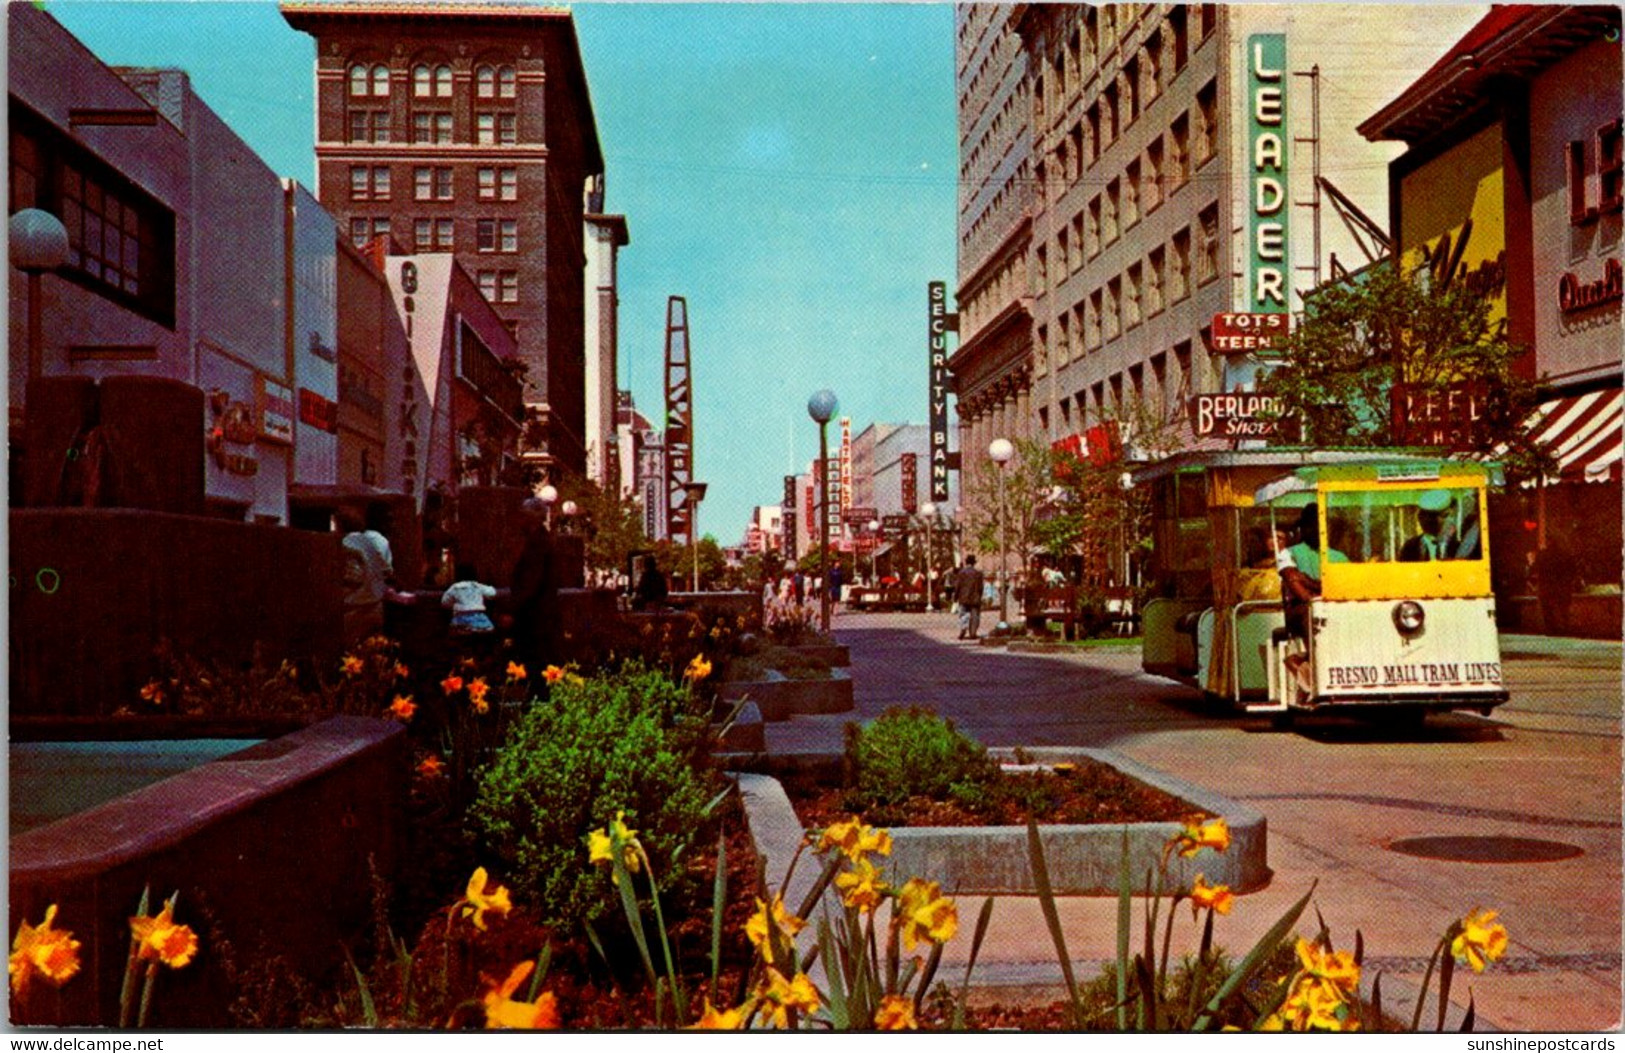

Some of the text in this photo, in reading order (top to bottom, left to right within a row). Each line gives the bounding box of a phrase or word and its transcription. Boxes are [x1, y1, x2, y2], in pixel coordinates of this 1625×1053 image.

[1253, 42, 1285, 304] LEADER
[1221, 313, 1281, 328] TOTS
[1215, 335, 1279, 350] TEEN
[931, 286, 947, 496] SECURITY BANK
[1328, 661, 1500, 685] FRESNO MALL TRAM LINES
